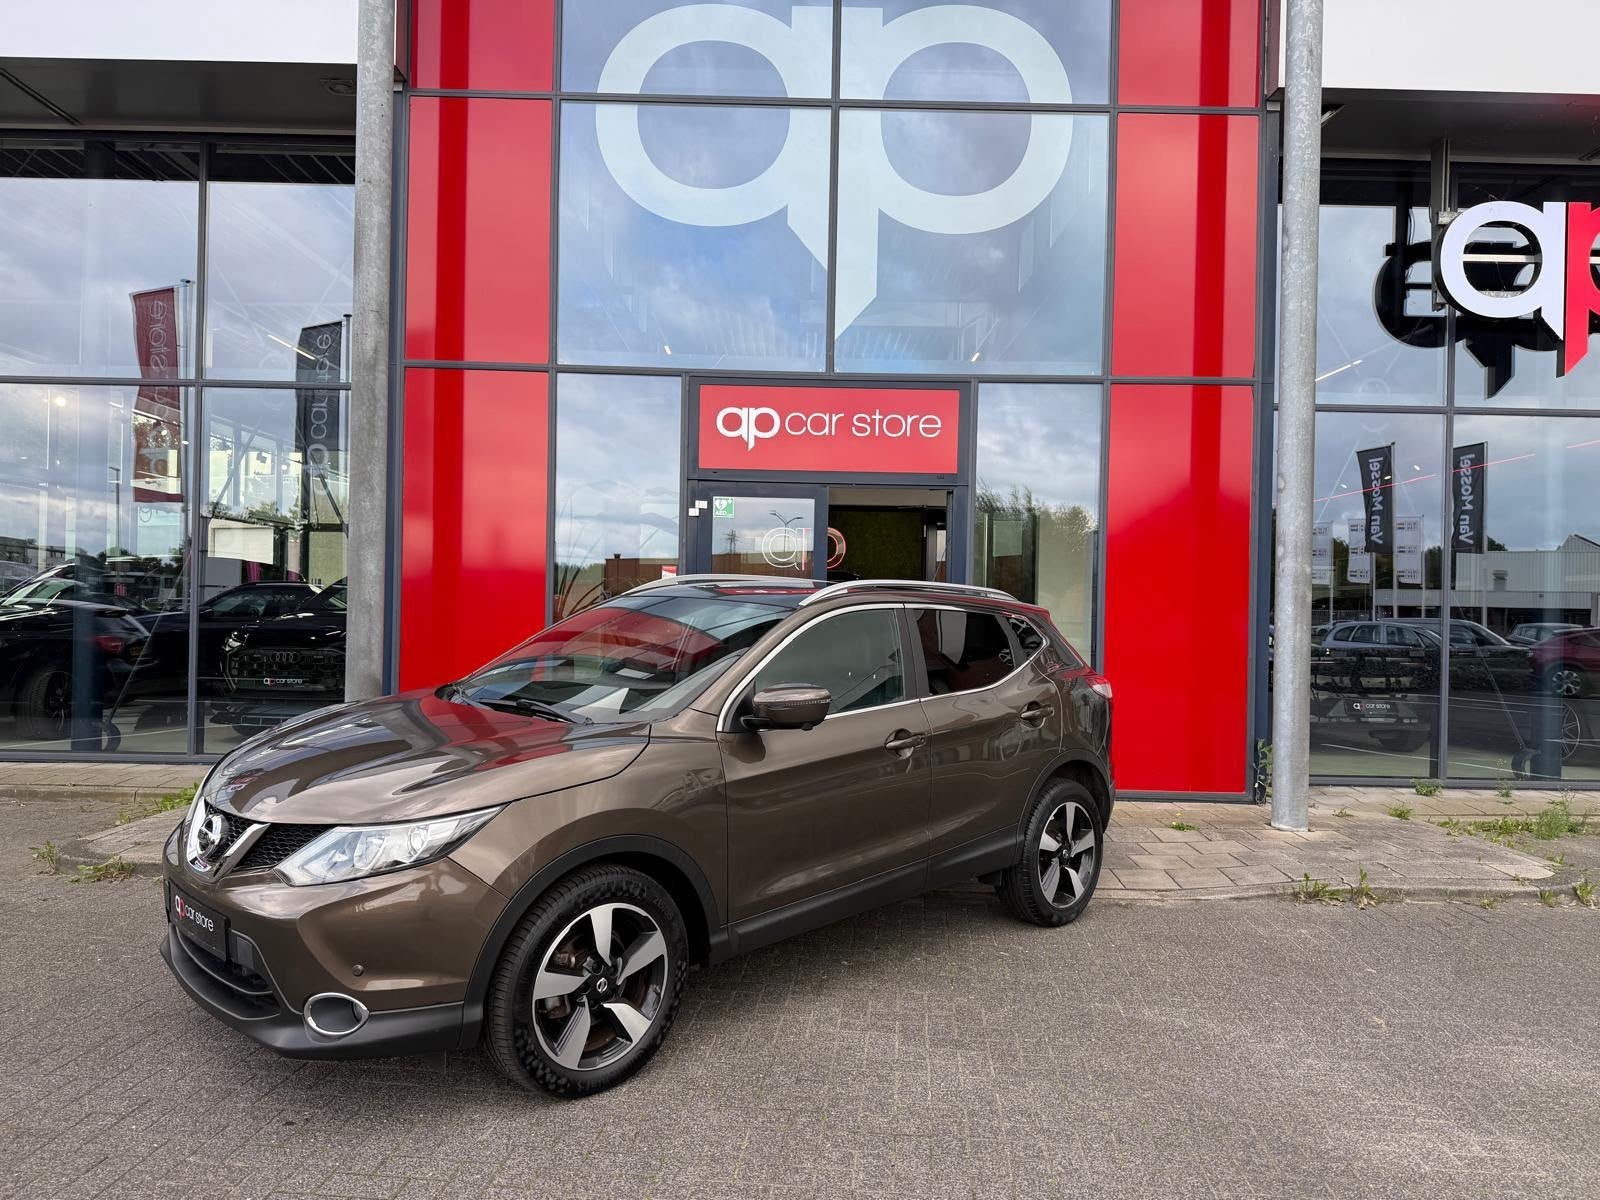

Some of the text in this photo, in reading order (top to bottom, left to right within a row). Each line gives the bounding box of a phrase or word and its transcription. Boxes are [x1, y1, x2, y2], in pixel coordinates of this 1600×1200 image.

[1440, 200, 1600, 377] a
[716, 406, 942, 450] ap car store
[185, 904, 195, 920] car
[195, 911, 214, 932] store
